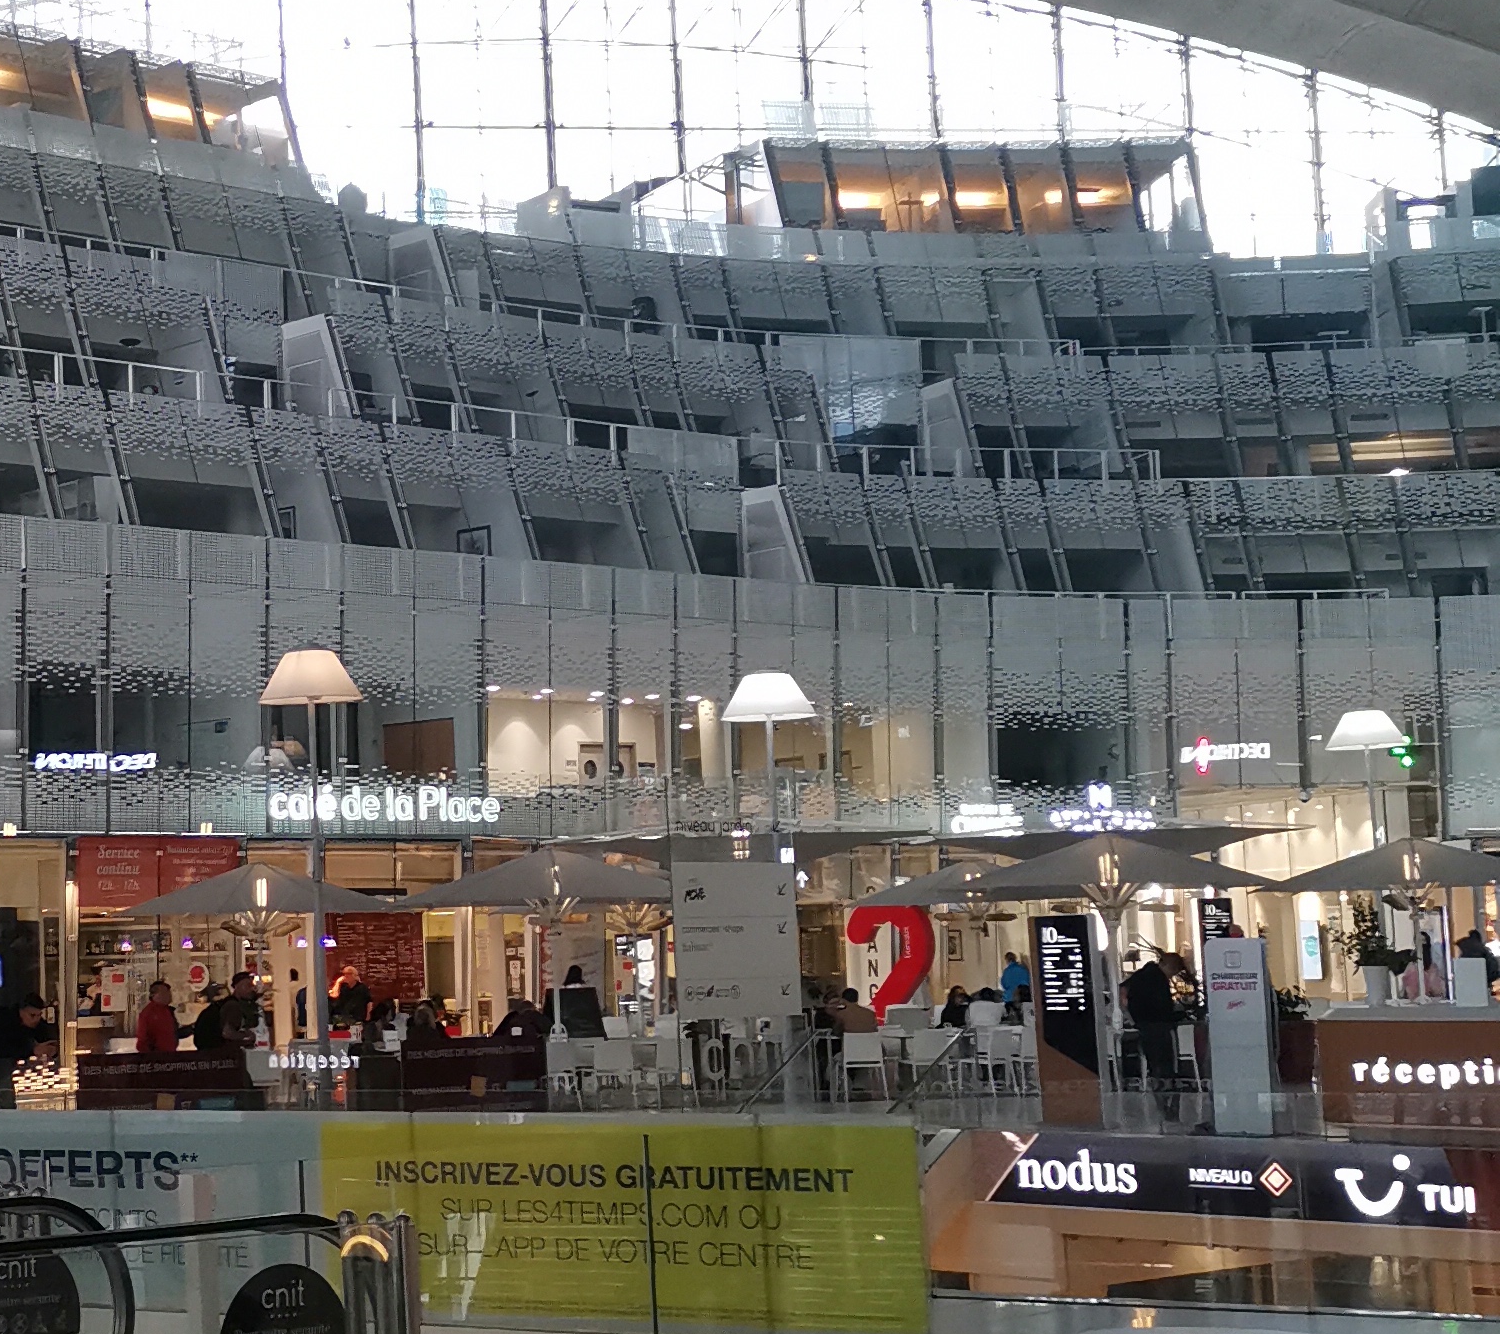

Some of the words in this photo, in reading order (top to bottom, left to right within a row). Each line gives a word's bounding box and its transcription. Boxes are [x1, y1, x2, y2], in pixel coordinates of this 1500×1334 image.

[341, 785, 381, 821] de
[386, 786, 415, 822] la
[418, 785, 501, 823] Place
[675, 821, 715, 833] niveau
[97, 845, 141, 859] Service
[1211, 981, 1258, 991] GRATUIT
[1351, 1055, 1500, 1091] récepti
[375, 1159, 607, 1189] INSCRIVEZ-VOUS
[614, 1163, 854, 1193] GRATUITEMENT
[1016, 1148, 1140, 1195] nodus
[440, 1197, 494, 1225] SUR
[738, 1203, 782, 1231] OU
[1418, 1183, 1477, 1214] TUI
[417, 1231, 469, 1257] SUR
[555, 1237, 591, 1263] DE
[598, 1238, 689, 1266] VOTRE
[698, 1241, 815, 1271] CENTRE
[261, 1278, 305, 1310] cnit
